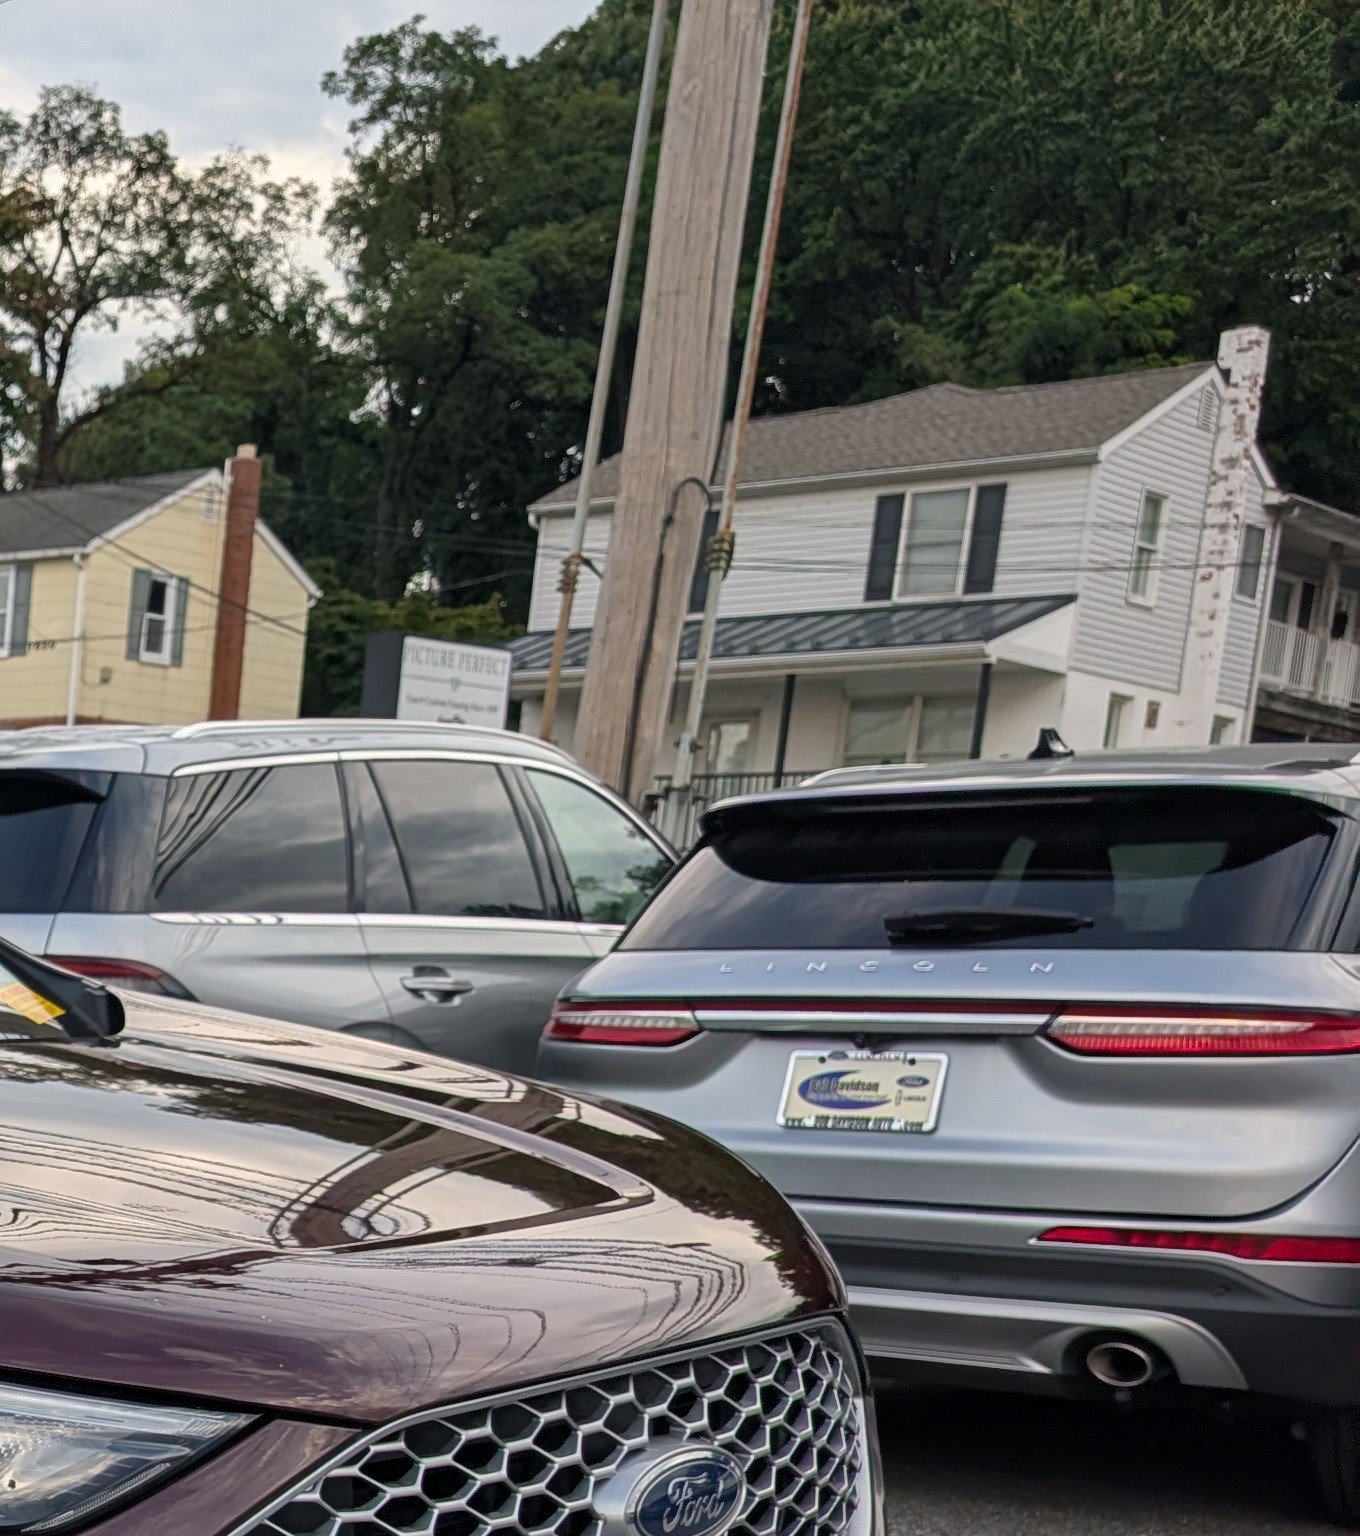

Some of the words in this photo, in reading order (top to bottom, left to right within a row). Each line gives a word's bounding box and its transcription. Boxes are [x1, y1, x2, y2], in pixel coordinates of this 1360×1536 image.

[719, 960, 1055, 975] LINCOLN
[831, 1077, 880, 1092] Davidson
[662, 1471, 725, 1533] Ford
